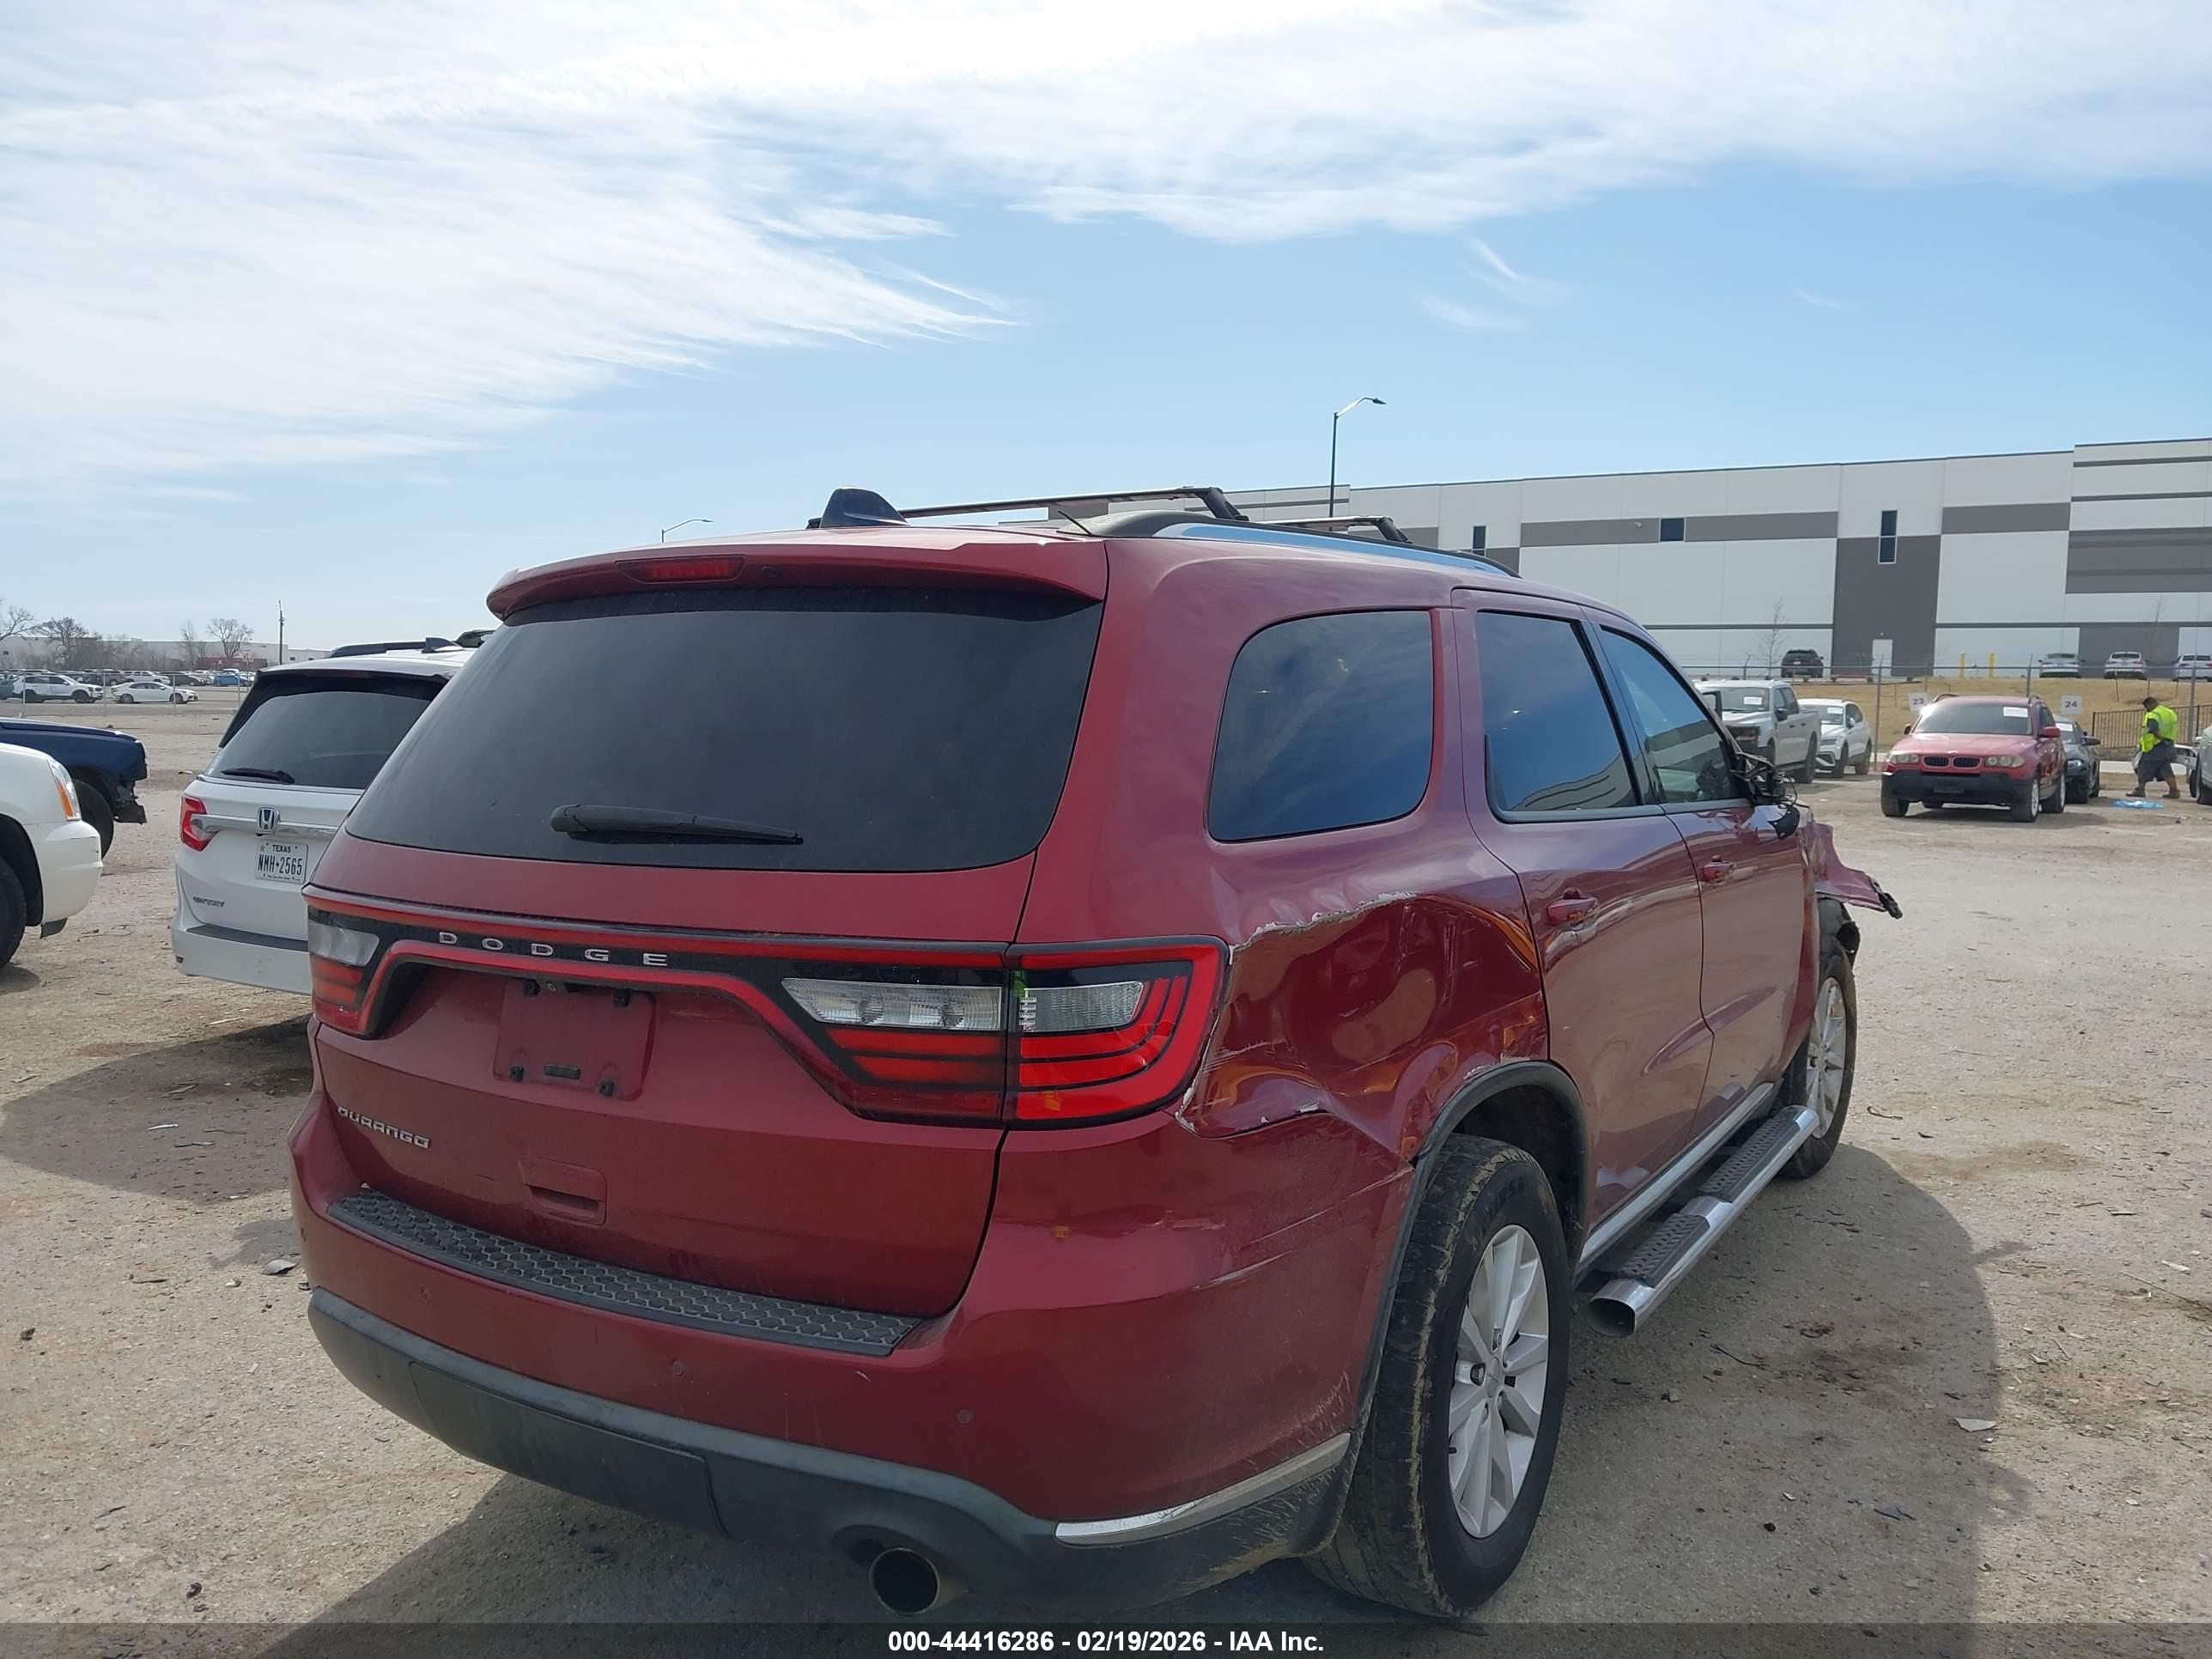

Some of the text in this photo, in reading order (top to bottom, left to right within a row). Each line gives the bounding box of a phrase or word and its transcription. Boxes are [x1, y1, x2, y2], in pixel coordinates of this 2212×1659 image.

[2064, 700, 2078, 708] 24
[272, 844, 291, 853] TEXAS
[439, 932, 667, 967] DODGE
[337, 1105, 429, 1149] DURANGO
